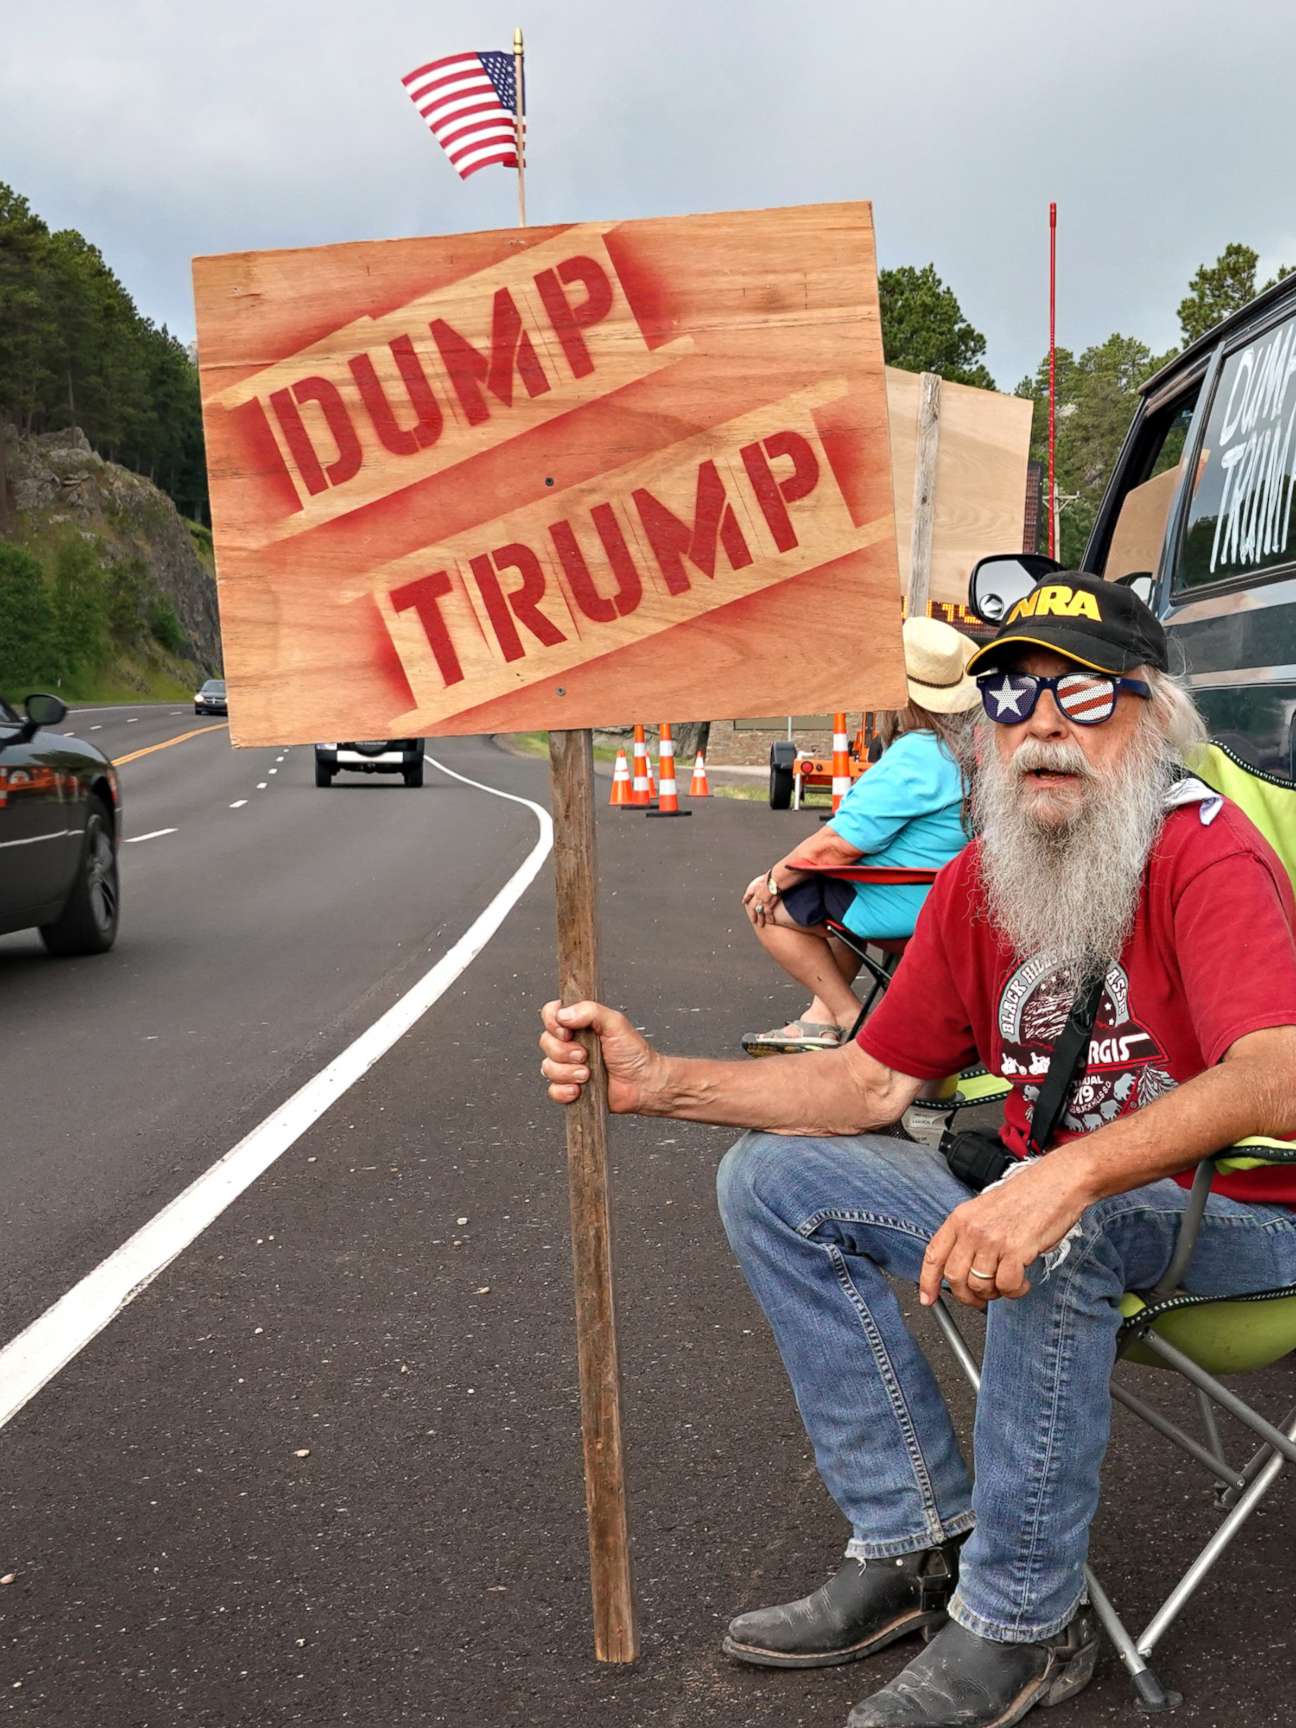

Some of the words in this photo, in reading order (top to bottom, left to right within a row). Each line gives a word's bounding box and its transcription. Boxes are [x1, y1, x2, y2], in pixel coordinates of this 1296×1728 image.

[269, 255, 614, 496] DUMP
[390, 430, 820, 689] TRUMP
[1007, 585, 1103, 625] NRA
[1001, 979, 1027, 1035] BLACK
[1088, 1032, 1151, 1065] RGIS
